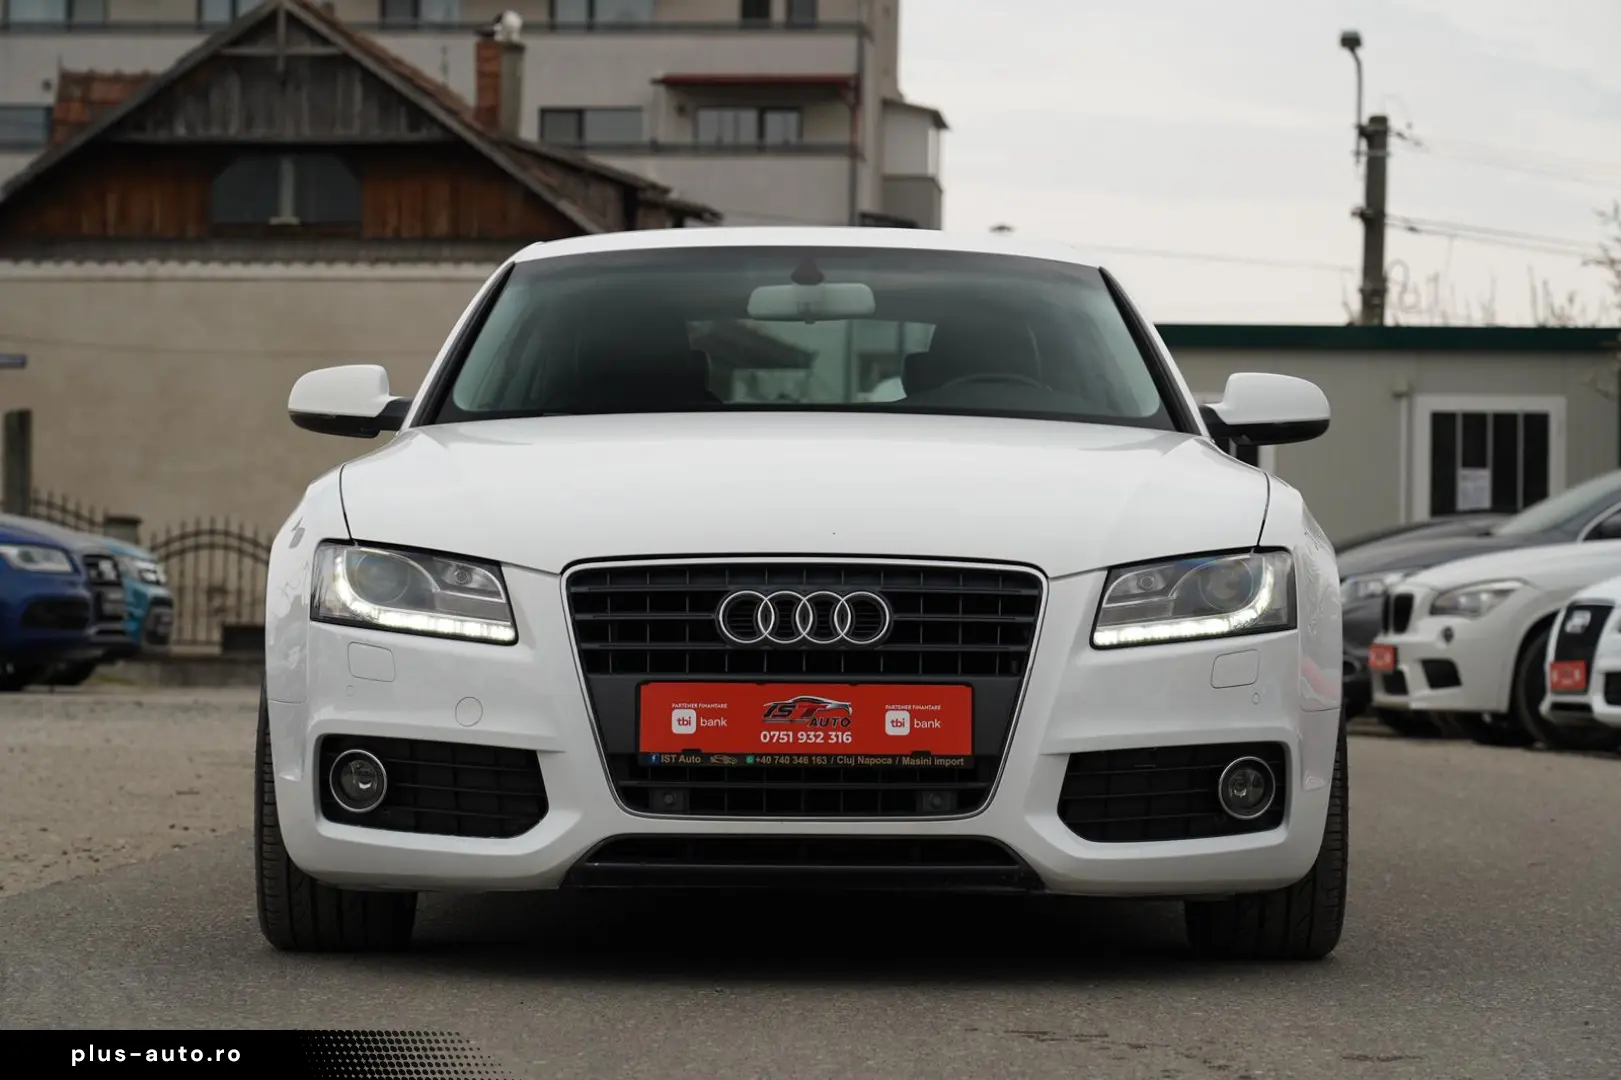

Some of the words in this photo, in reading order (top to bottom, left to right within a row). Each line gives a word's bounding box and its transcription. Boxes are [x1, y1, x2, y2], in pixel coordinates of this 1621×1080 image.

[677, 716, 692, 727] tbi
[700, 717, 728, 727] bank
[808, 717, 851, 728] AUTO
[890, 718, 905, 728] tbi
[914, 719, 941, 729] bank
[760, 731, 793, 743] 0751
[797, 731, 825, 743] 932
[828, 731, 853, 743] 316
[660, 755, 677, 764] IST
[679, 755, 702, 764] Auto
[755, 755, 772, 764] +40
[774, 755, 789, 765] 740
[837, 755, 855, 767] Cluj
[857, 756, 893, 767] Napoca
[902, 757, 932, 766] Masini
[934, 757, 964, 768] import
